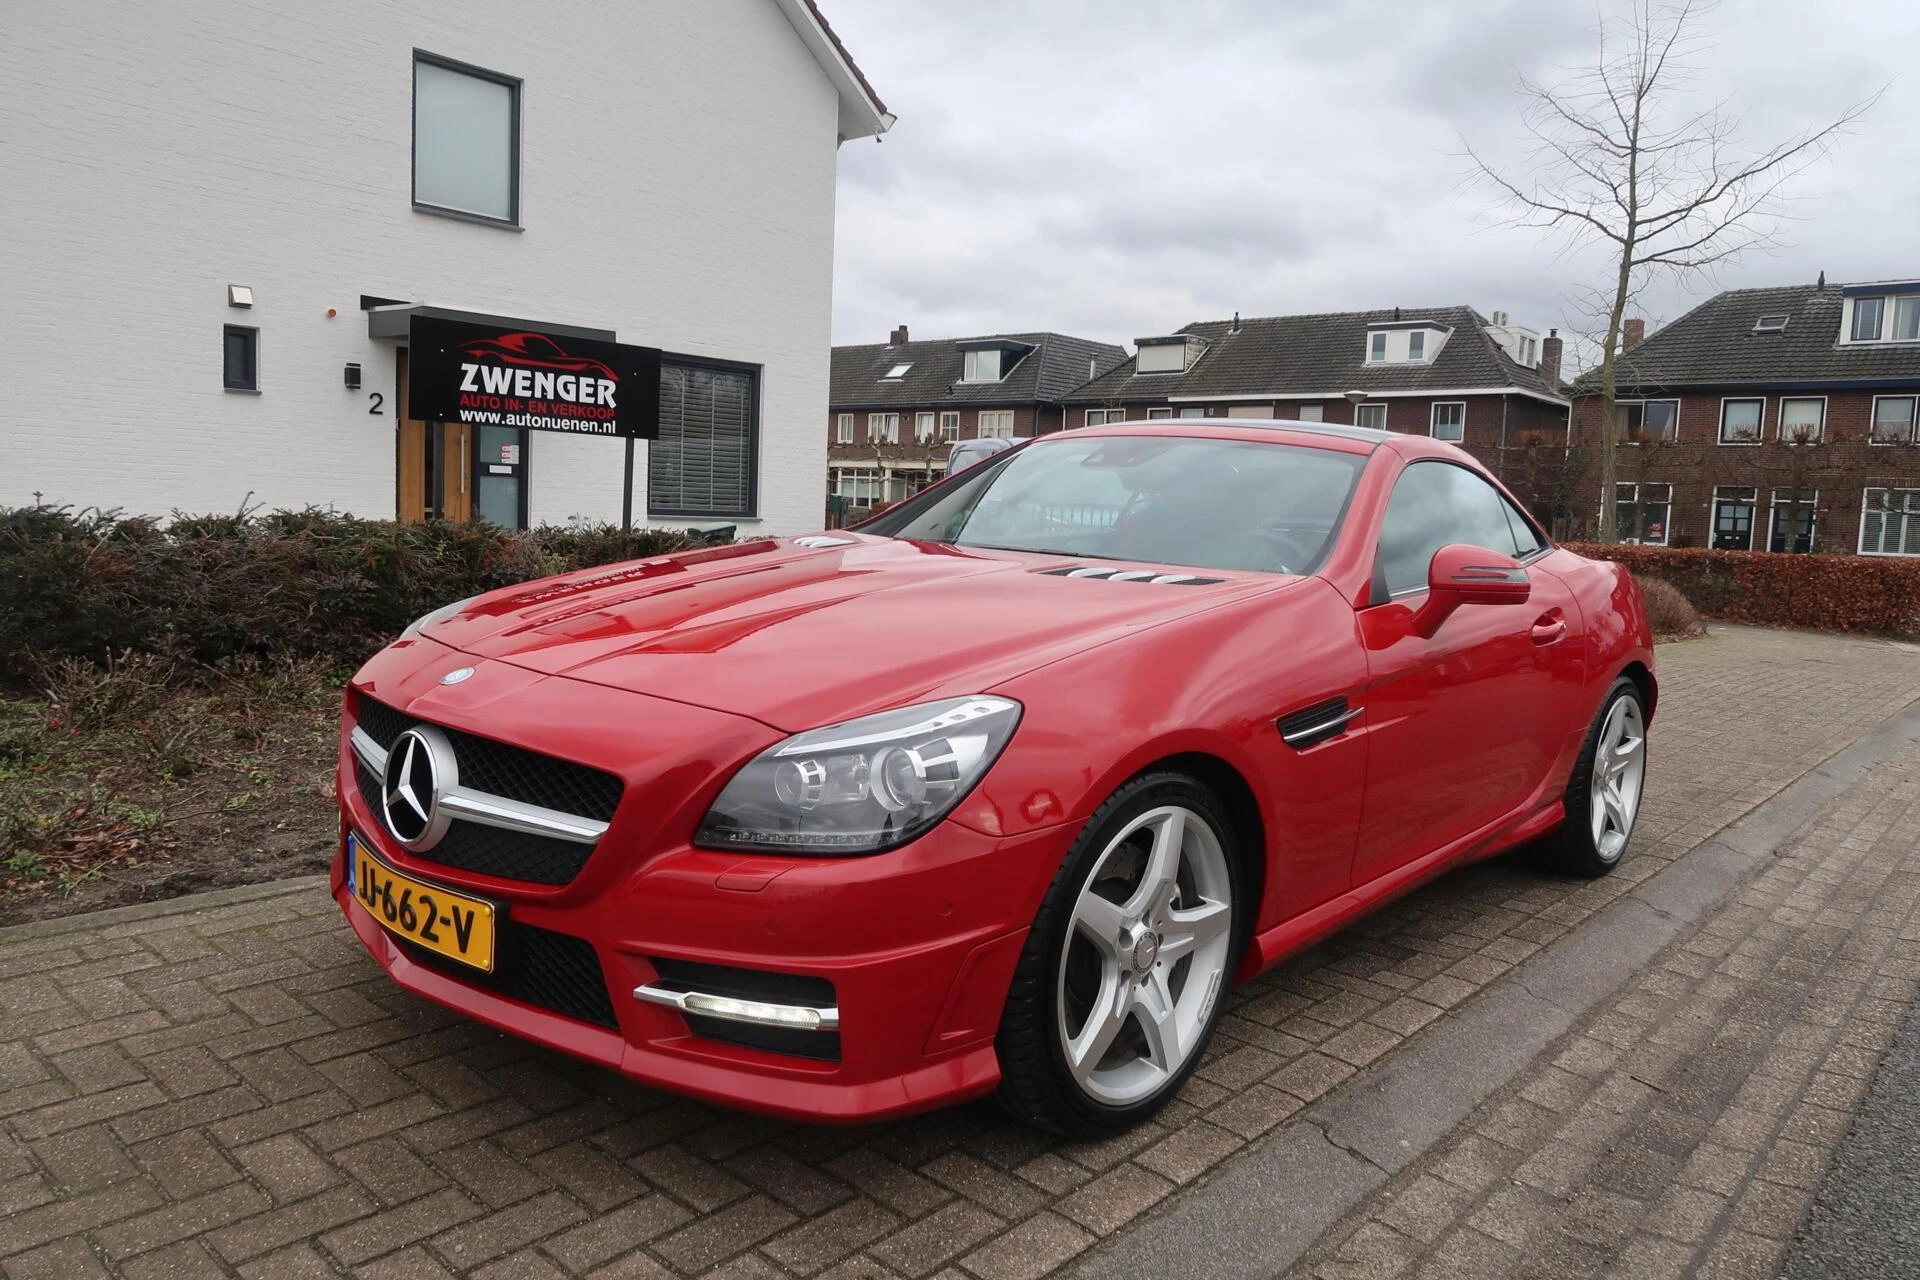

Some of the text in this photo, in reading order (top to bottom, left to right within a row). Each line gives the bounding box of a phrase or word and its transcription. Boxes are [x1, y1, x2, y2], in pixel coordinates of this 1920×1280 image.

[460, 363, 617, 409] ZWENGER
[369, 392, 384, 415] 2
[460, 394, 616, 421] AUTO IN- EN VERKOOP
[460, 409, 617, 434] www.autonuenen.nl
[359, 861, 475, 954] JJ-662-V
